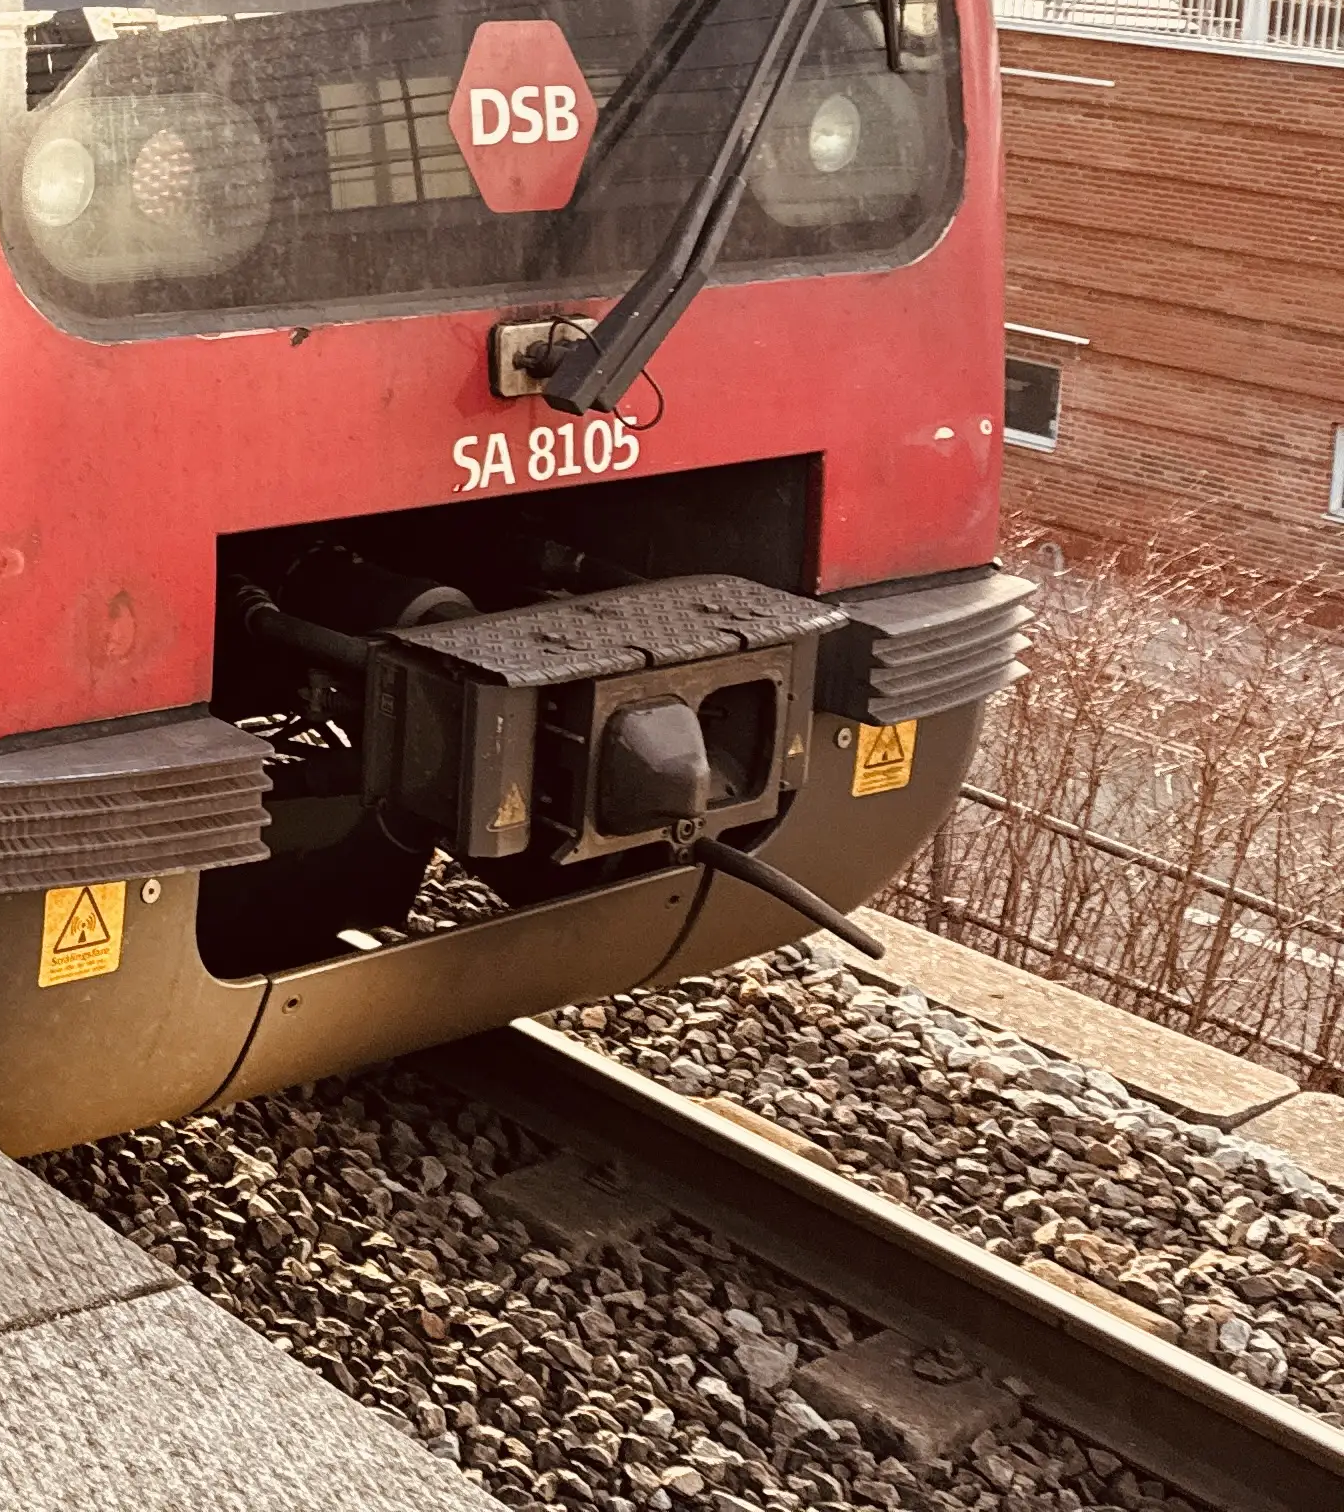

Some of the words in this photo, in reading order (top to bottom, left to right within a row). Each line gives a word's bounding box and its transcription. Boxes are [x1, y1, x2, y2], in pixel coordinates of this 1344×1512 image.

[469, 85, 580, 147] DSB
[452, 432, 516, 492] SA
[527, 415, 640, 482] 8105
